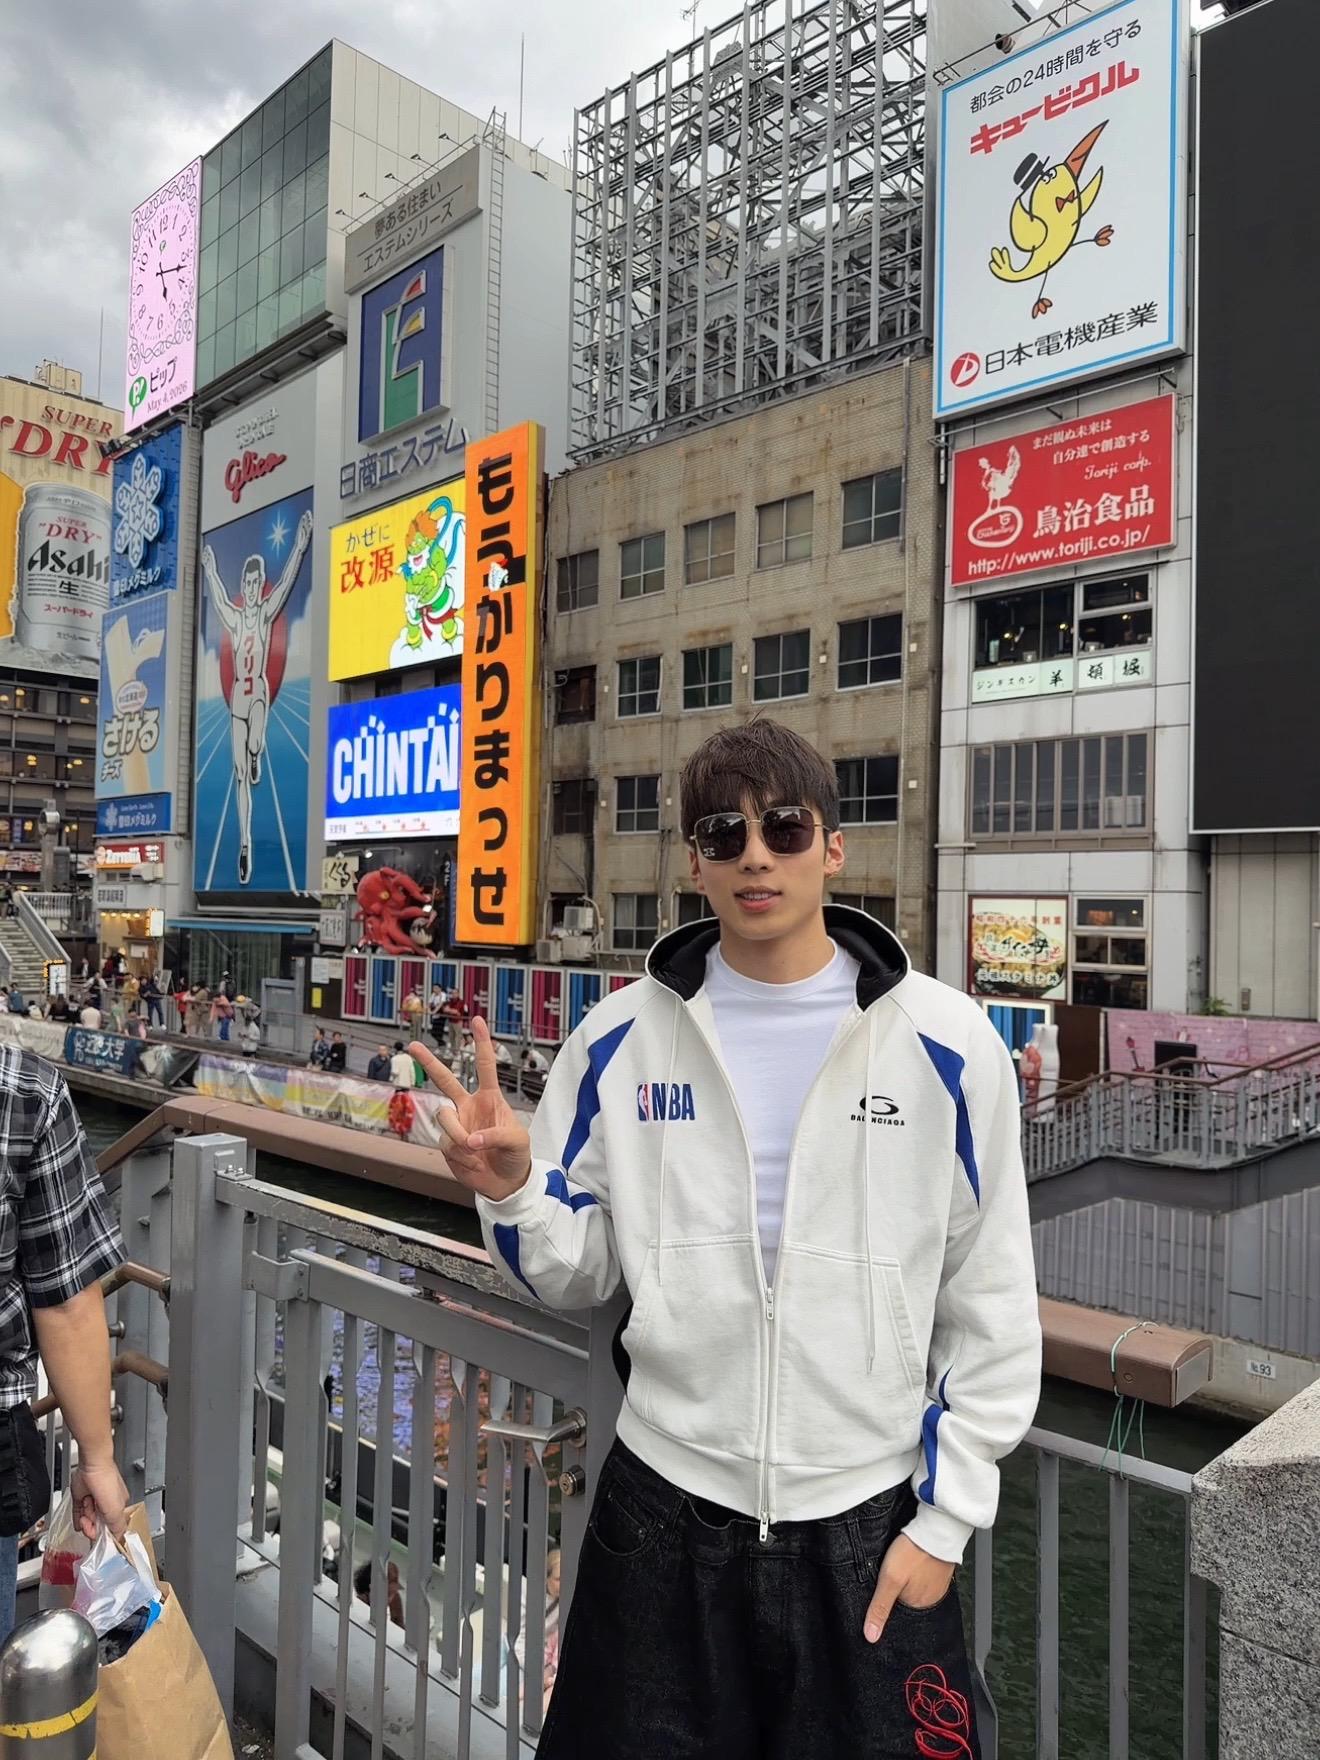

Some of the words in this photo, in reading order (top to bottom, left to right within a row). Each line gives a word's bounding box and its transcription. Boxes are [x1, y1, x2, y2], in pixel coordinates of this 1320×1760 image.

[970, 19, 1141, 113] 都会の24時間を守る
[970, 60, 1140, 154] キュービクル
[364, 198, 454, 273] エステムシリーズ
[374, 182, 442, 240] 夢ある住まい
[985, 301, 1158, 375] 日本電機産業
[150, 356, 178, 393] ピップ
[41, 405, 113, 438] SUPER
[1053, 429, 1150, 465] 自分達で創造する
[225, 450, 287, 504] Glico
[340, 417, 471, 500] 日商エステム
[1084, 462, 1119, 480] Toriji
[1033, 484, 1155, 539] 鳥治食品
[28, 539, 109, 584] Asahi
[346, 525, 391, 553] かぜに
[968, 524, 1151, 576] http://www.toriji.co.jp/
[59, 580, 79, 596] 生
[340, 544, 396, 595] 改源
[44, 603, 94, 618] スーパードライ
[103, 707, 160, 759] さける
[333, 702, 460, 803] CHINTAI
[652, 1082, 696, 1121] NBA
[850, 1114, 905, 1127] BALNCIAGA
